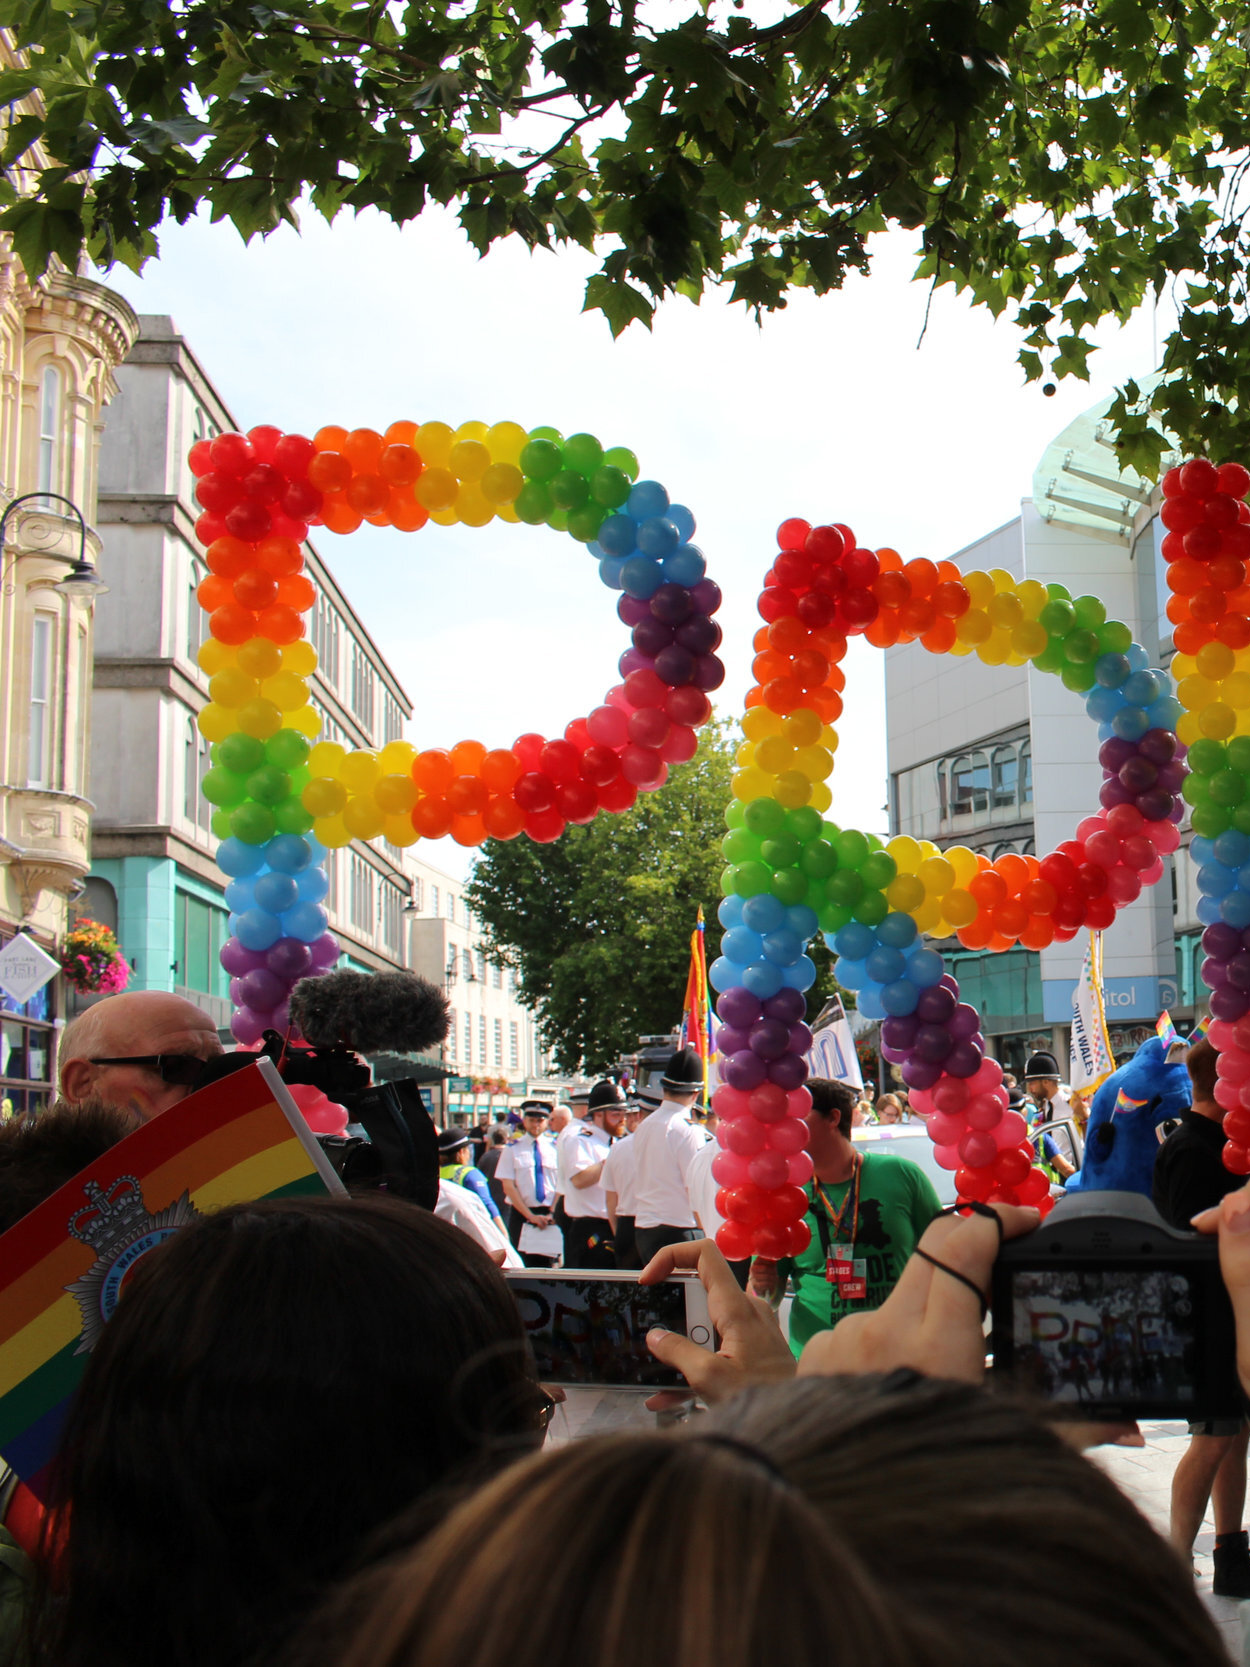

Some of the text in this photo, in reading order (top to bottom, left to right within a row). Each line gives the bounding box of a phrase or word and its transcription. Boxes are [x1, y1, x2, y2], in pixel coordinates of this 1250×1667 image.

[1078, 1034, 1094, 1077] WALES
[117, 1237, 154, 1269] WALES
[842, 1283, 862, 1292] CREW
